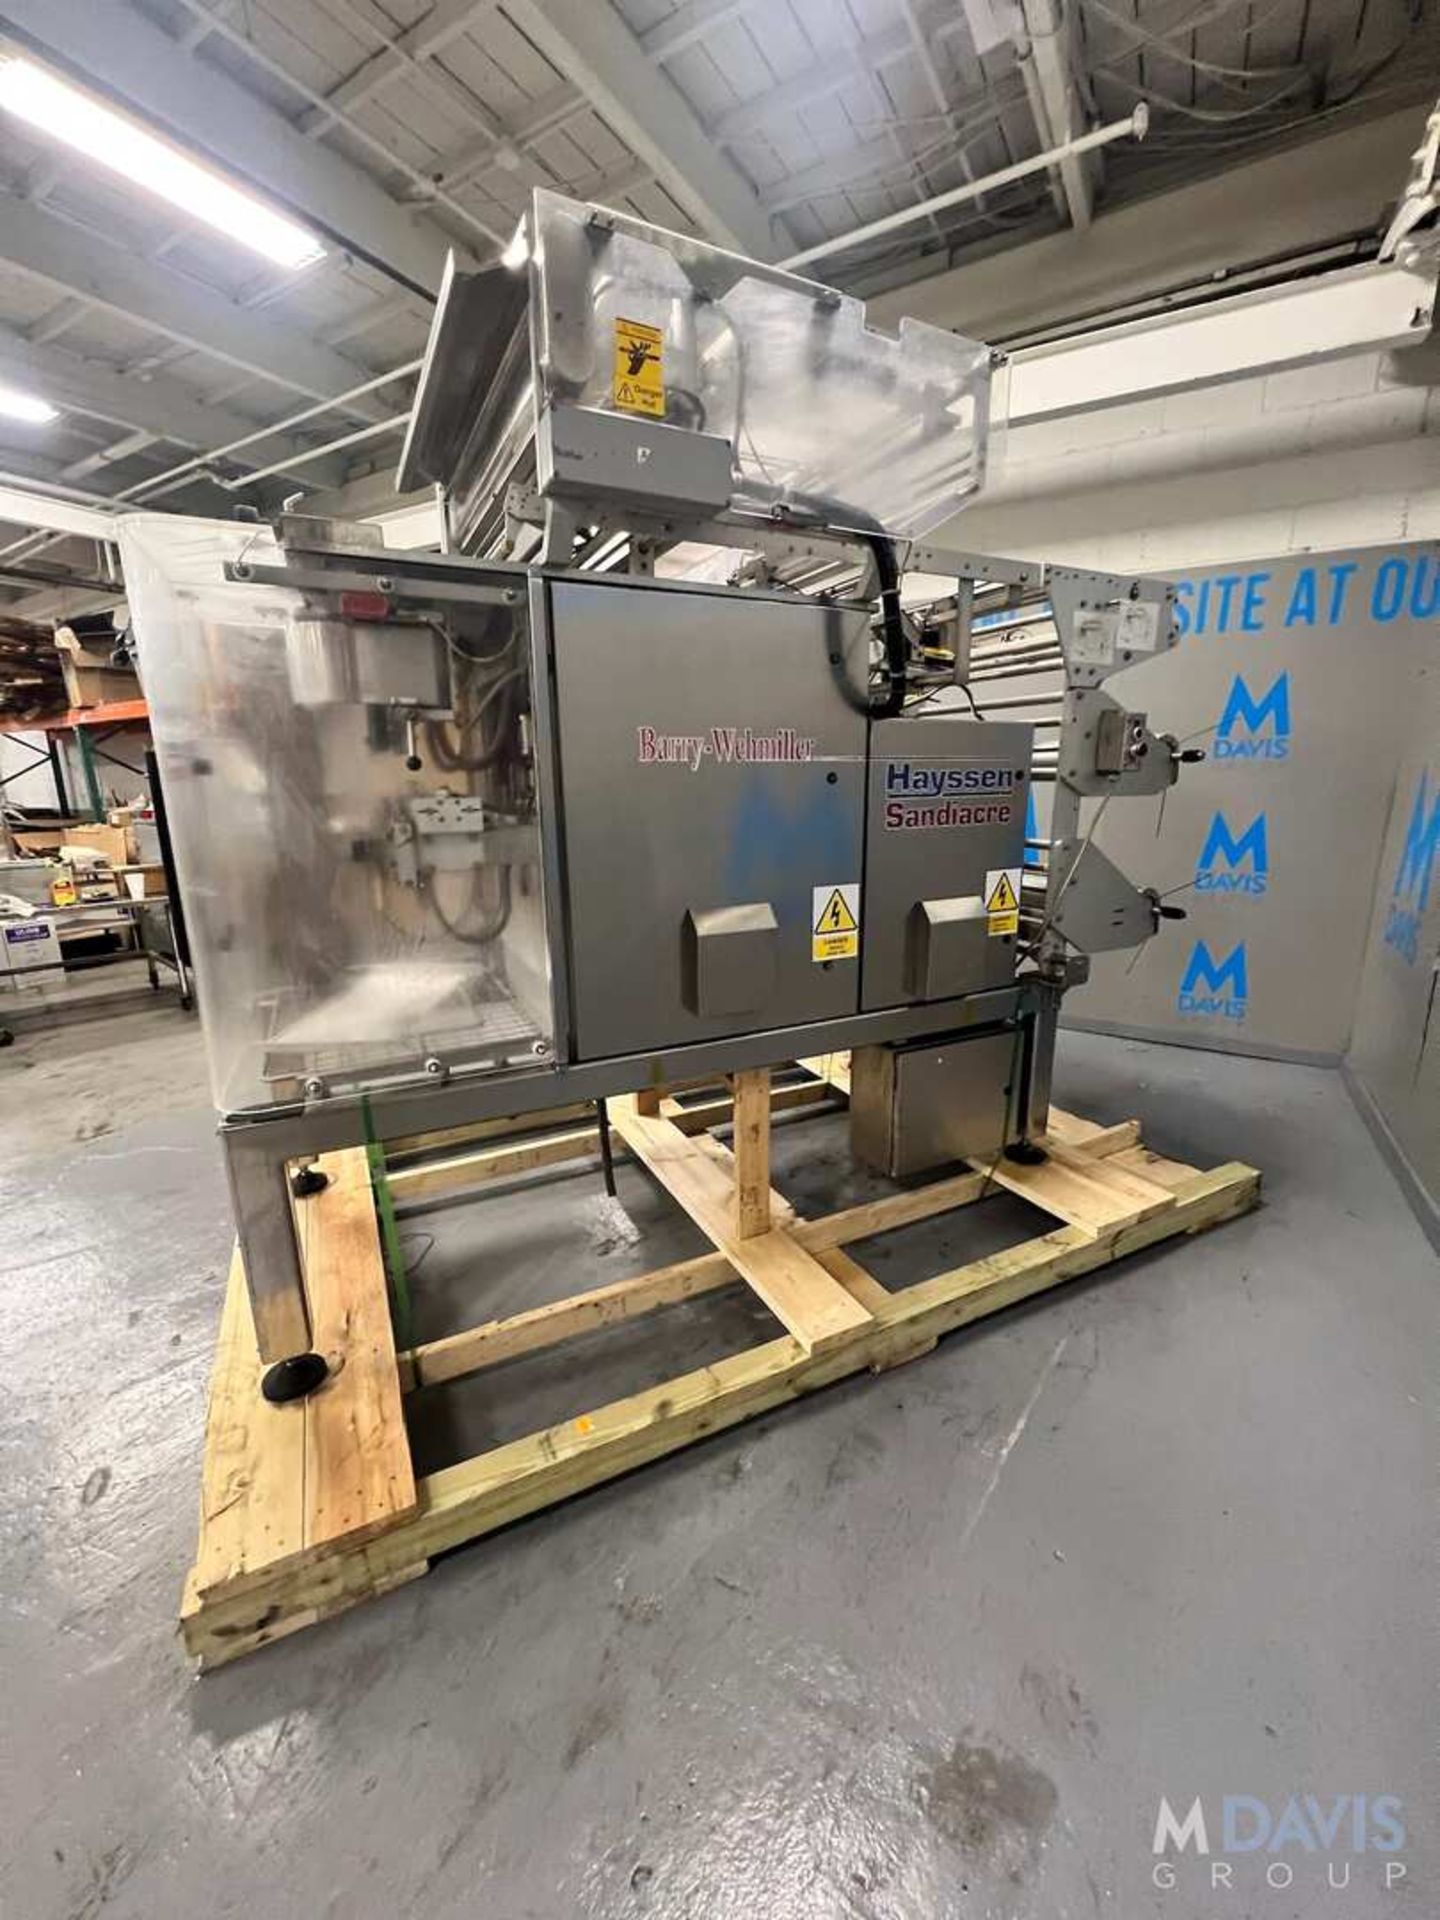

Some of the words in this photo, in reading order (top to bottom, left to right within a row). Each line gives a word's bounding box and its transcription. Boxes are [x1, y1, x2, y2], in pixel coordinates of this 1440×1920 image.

[1283, 563, 1358, 628] AT
[1216, 669, 1292, 739] M
[637, 726, 814, 772] Barry-Wehmiller
[1213, 738, 1289, 759] DAVIS
[885, 763, 1013, 798] Hayssen
[886, 801, 1011, 829] Sandiacre
[1196, 809, 1268, 873] M
[1195, 871, 1267, 894] DAVIS
[1180, 940, 1246, 999] M
[1178, 995, 1245, 1018] DAVIS
